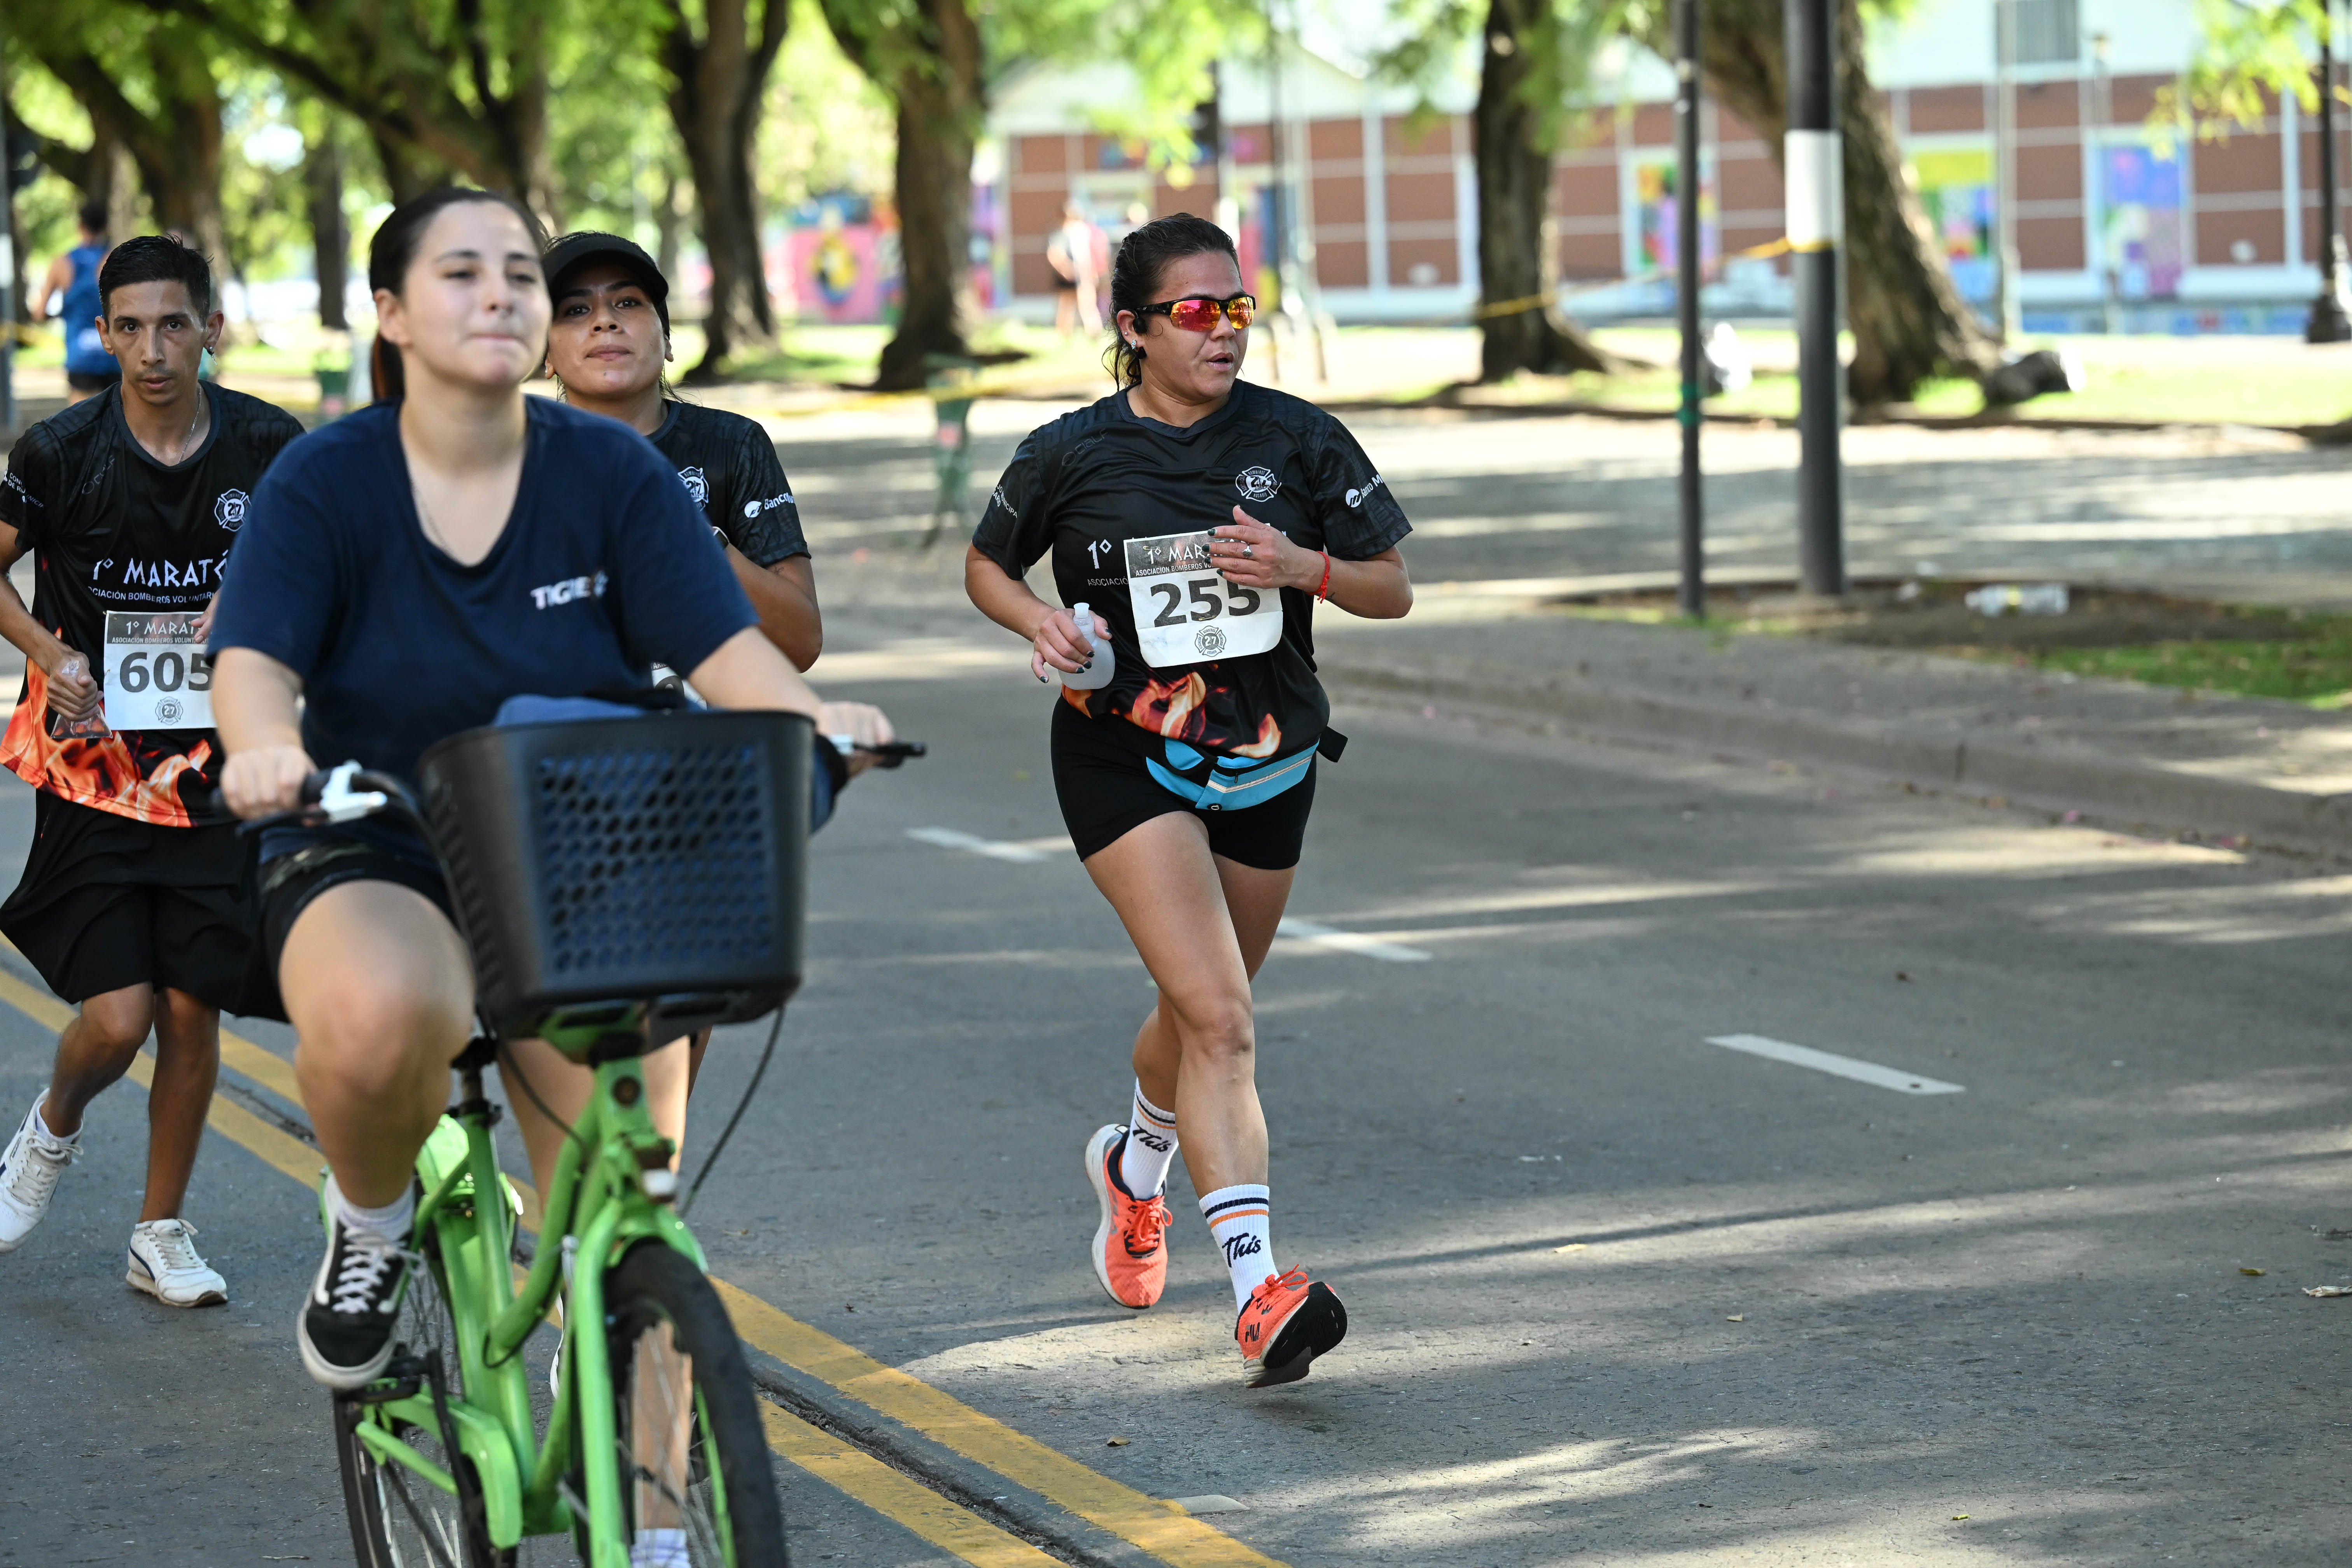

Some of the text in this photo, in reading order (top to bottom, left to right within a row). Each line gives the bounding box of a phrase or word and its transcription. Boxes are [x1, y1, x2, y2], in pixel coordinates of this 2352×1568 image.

[228, 502, 242, 516] 27
[1172, 563, 1202, 572] BOMBEROS
[128, 592, 170, 604] BOMBEROS
[1150, 578, 1260, 627] 255
[1204, 635, 1217, 647] 27
[119, 652, 214, 693] 605
[164, 705, 176, 716] 27
[1222, 1232, 1261, 1268] This
